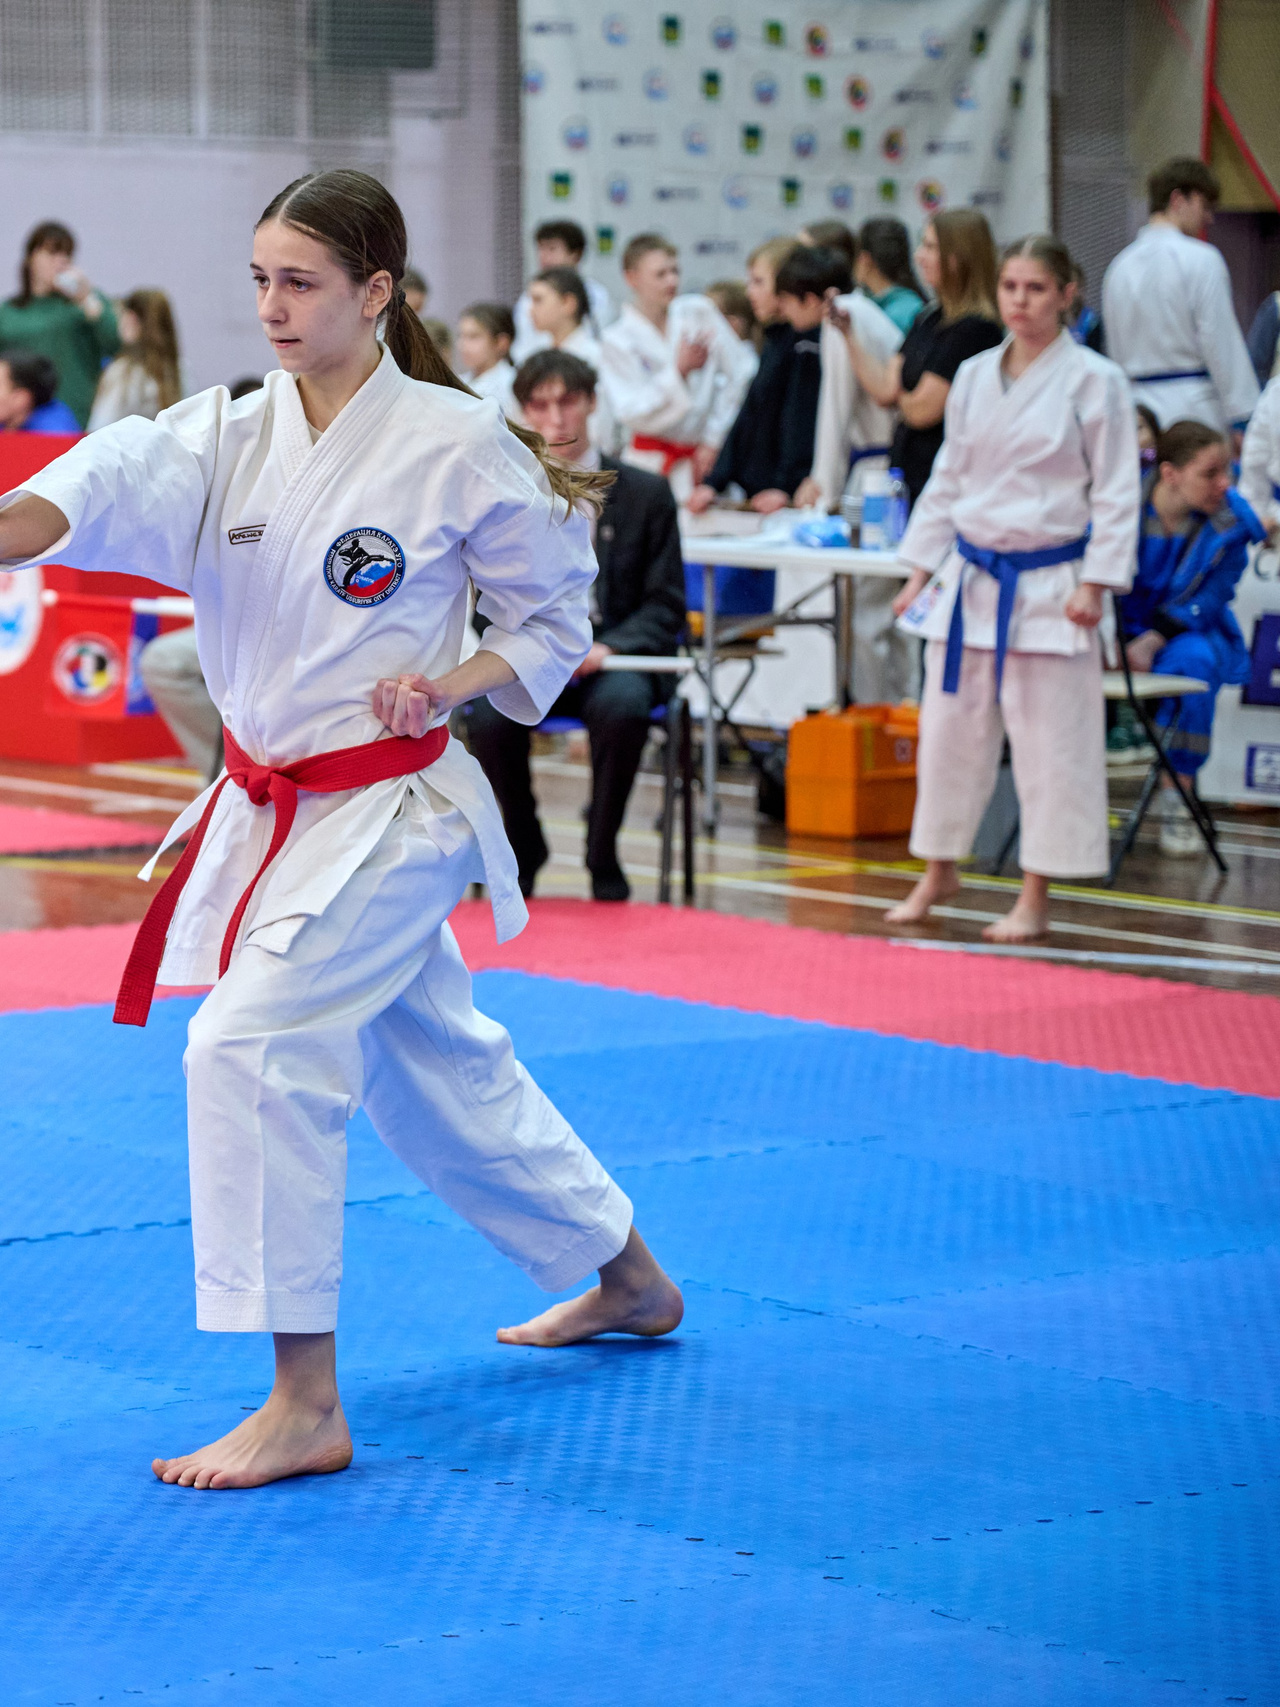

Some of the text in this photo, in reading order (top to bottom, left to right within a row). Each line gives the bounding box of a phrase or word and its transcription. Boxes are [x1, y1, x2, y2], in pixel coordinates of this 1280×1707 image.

[336, 529, 376, 547] ФЕДЕРАЦИЯ
[376, 533, 399, 553] КАРАТЭ
[330, 580, 346, 597] KARATE
[373, 592, 386, 603] CITY
